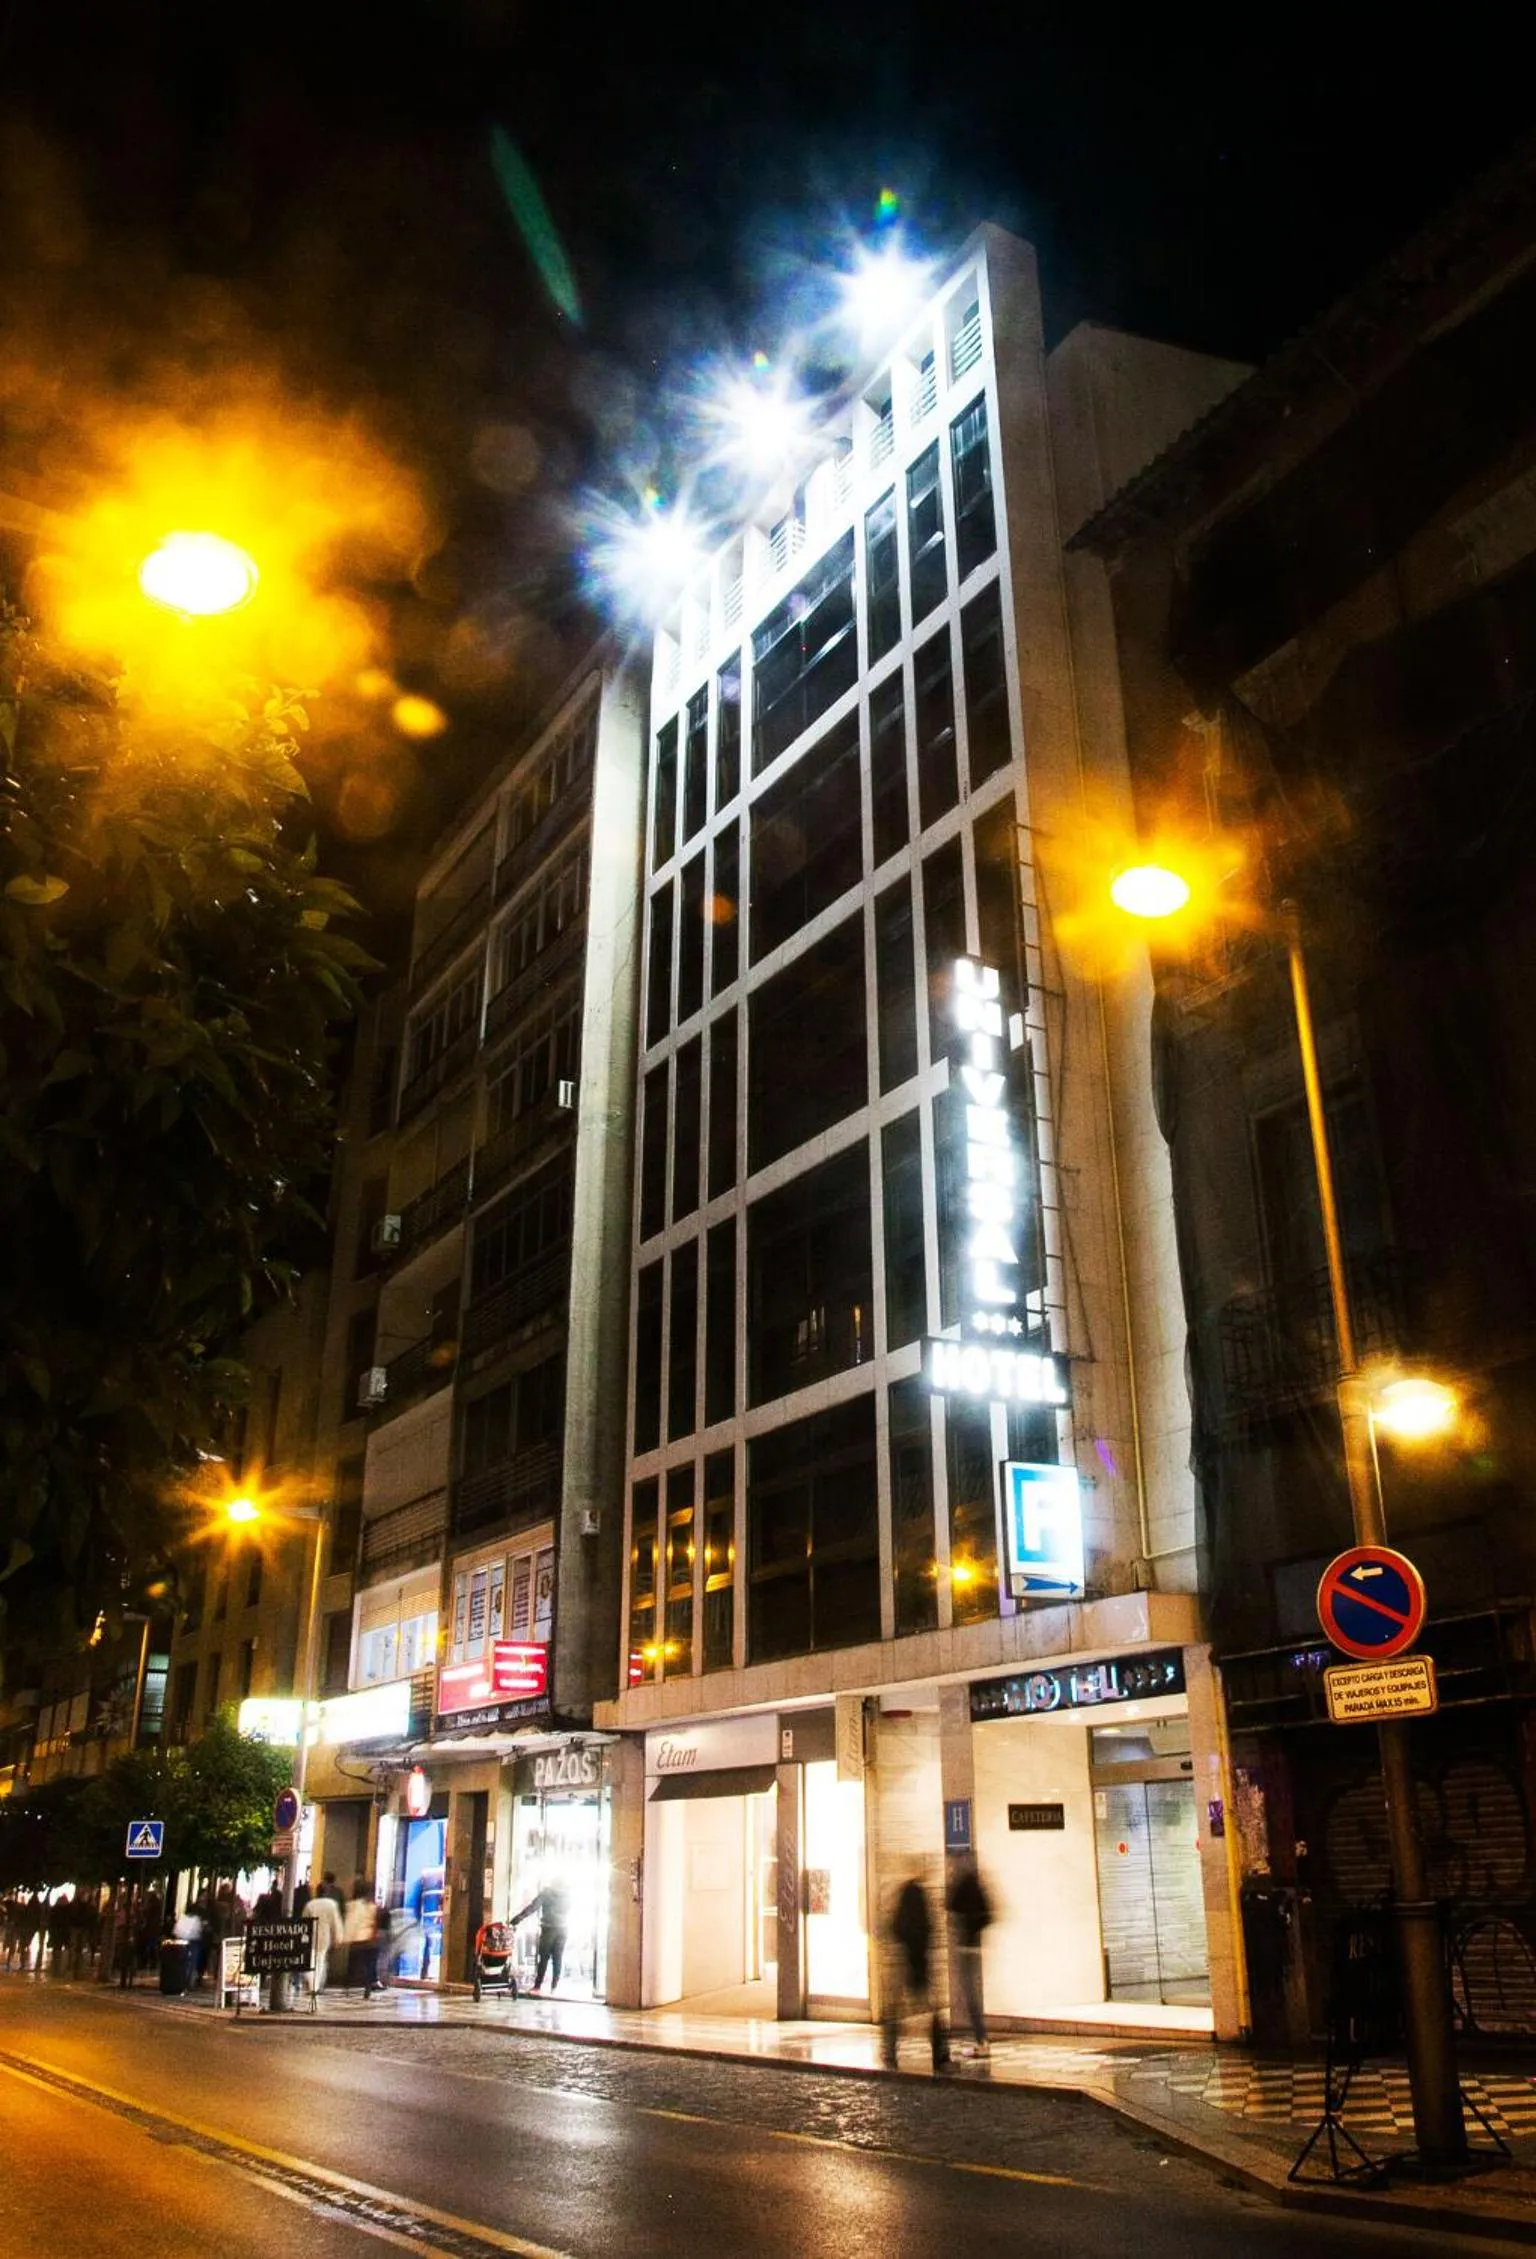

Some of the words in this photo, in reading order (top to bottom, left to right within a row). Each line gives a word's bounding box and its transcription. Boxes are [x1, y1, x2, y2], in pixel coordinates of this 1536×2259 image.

[955, 958, 1018, 1304] UNIVERSAL
[931, 1341, 1066, 1403] HOTEL
[1007, 1664, 1122, 1712] HOTEL
[1332, 1674, 1360, 1687] EXCEPTO
[1361, 1672, 1383, 1682] CARGA
[1383, 1671, 1389, 1680] Y
[1389, 1666, 1425, 1679] DESCARGA
[1334, 1691, 1344, 1701] DE
[1345, 1687, 1380, 1699] VIAJEROS
[1381, 1686, 1387, 1694] Y
[1387, 1680, 1427, 1693] EQUIPAJES
[1344, 1701, 1375, 1713] PARADA
[657, 1741, 698, 1769] Etam
[534, 1748, 594, 1788] PAZOS
[952, 1807, 964, 1832] H
[252, 1923, 308, 1937] RESERVADO
[264, 1939, 294, 1951] Hotel
[252, 1953, 304, 1968] Universal
